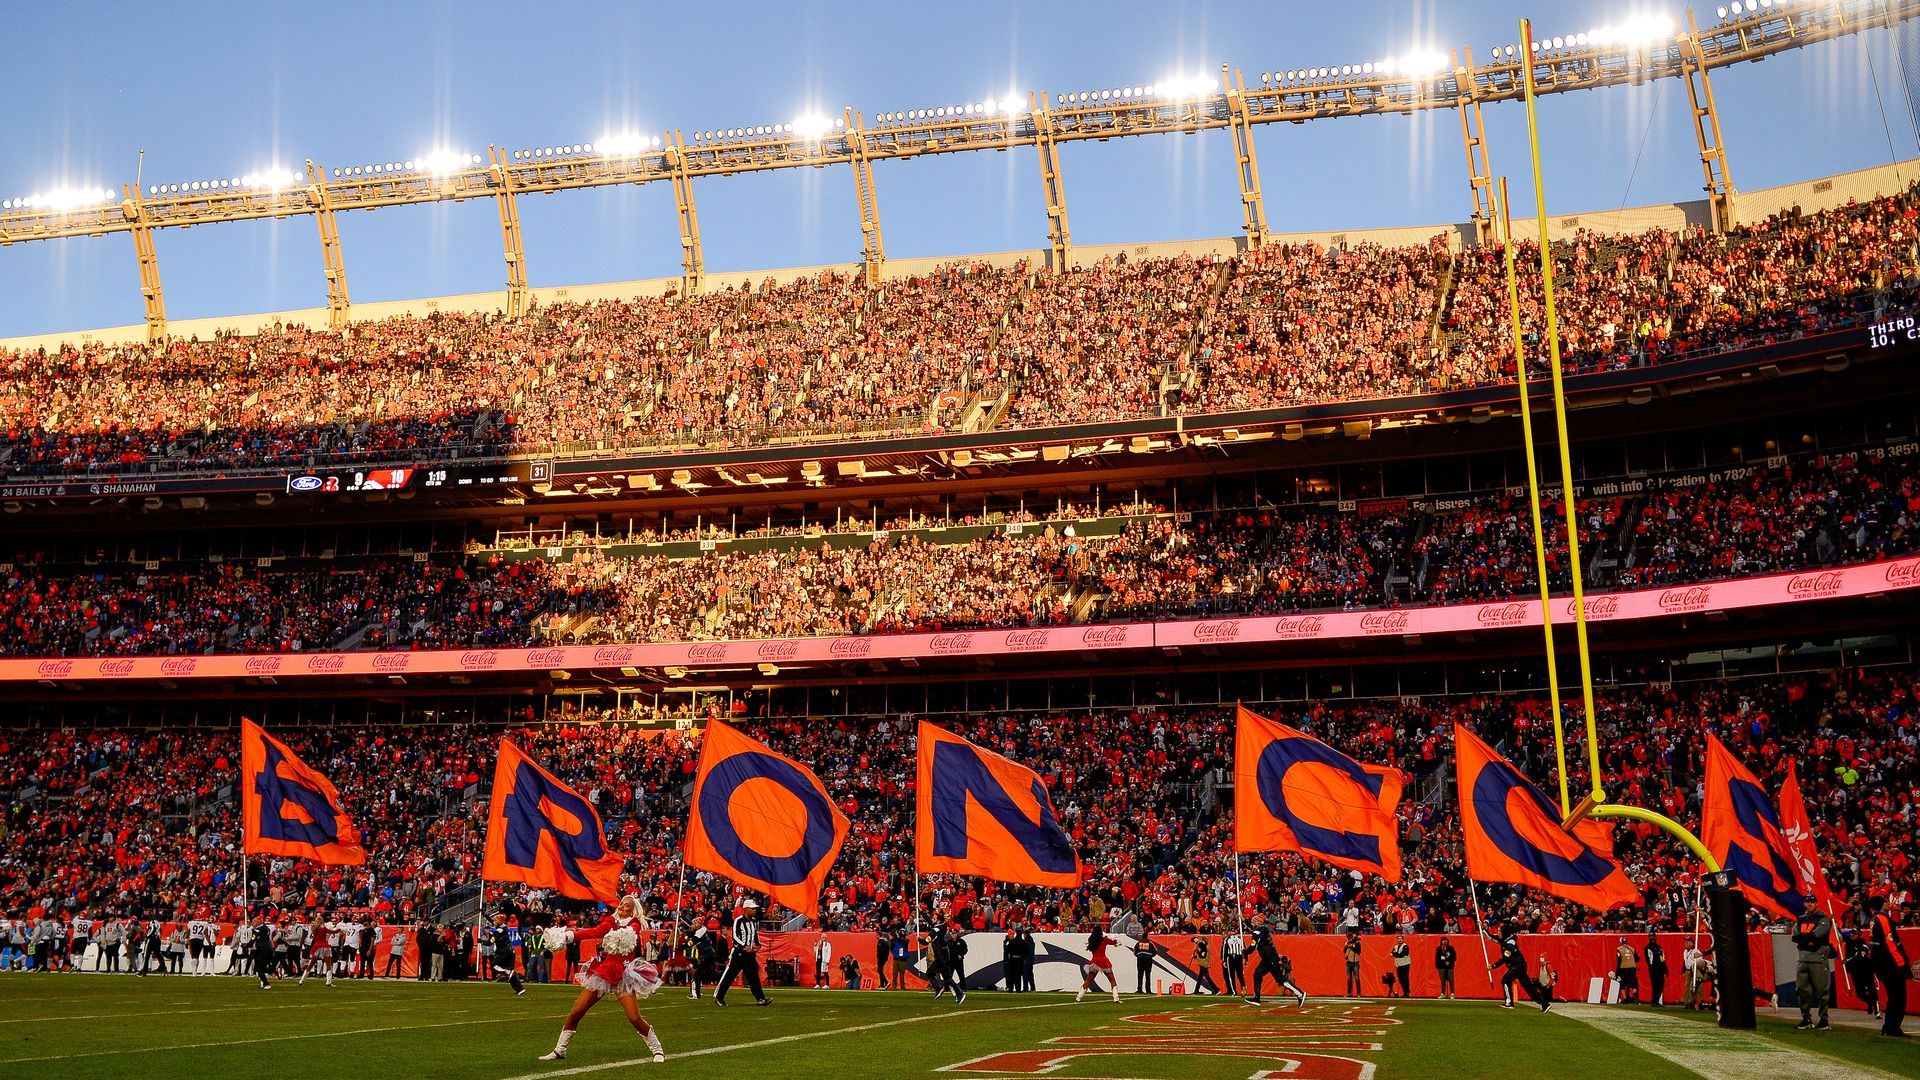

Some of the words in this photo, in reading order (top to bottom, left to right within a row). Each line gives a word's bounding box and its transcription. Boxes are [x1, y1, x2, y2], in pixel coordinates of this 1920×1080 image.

[1815, 182, 1831, 191] 540
[1563, 219, 1577, 227] 539
[1868, 317, 1914, 336] THIRD
[390, 470, 404, 483] 10
[428, 471, 446, 481] 1:15
[534, 467, 544, 477] 31
[354, 472, 363, 486] 9
[2, 488, 13, 497] 24
[15, 487, 52, 497] BAILEY
[102, 483, 156, 494] SHANAHAN
[1593, 485, 1618, 496] with
[1620, 482, 1643, 492] info
[1340, 502, 1355, 510] 342
[1435, 499, 1471, 510] issues
[1176, 513, 1190, 521] 341
[1007, 524, 1021, 532] 340
[701, 541, 714, 549] 338
[548, 547, 562, 556] 337
[258, 558, 271, 566] 335
[415, 553, 428, 561] 336
[146, 561, 159, 569] 334
[255, 734, 339, 846] B
[933, 740, 1076, 873] N
[1256, 736, 1384, 867] C
[699, 751, 835, 885] O
[502, 760, 605, 888] R
[1672, 893, 1679, 902] 9
[56, 925, 65, 935] 55
[77, 923, 88, 933] 98
[192, 924, 204, 934] 92
[862, 978, 872, 989] 10
[1173, 984, 1182, 994] G
